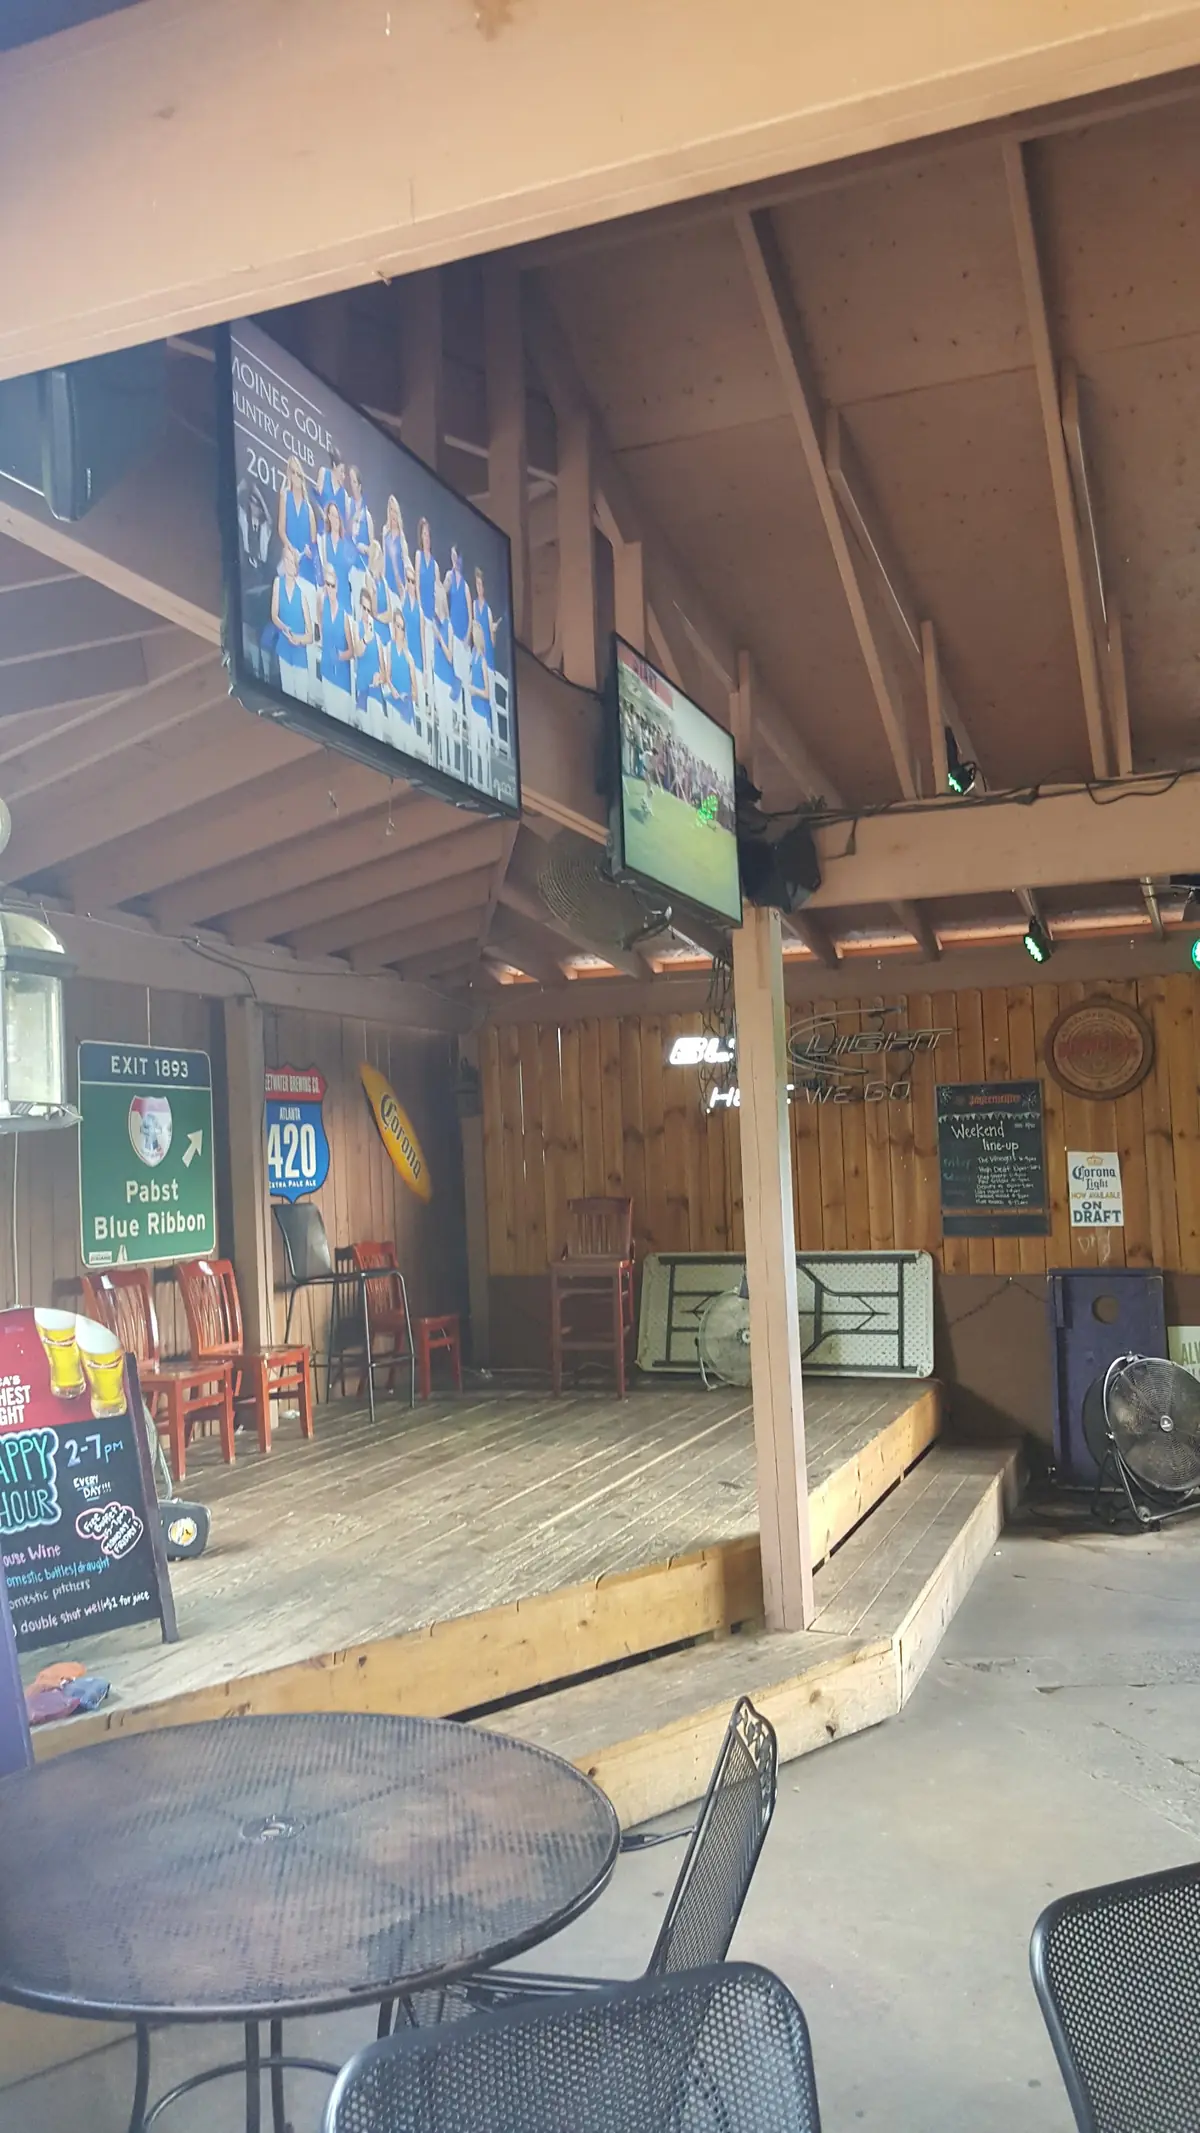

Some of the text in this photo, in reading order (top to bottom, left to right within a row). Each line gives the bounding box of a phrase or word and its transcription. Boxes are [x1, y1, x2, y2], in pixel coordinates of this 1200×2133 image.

[232, 390, 315, 467] UNTRY CLUB
[294, 408, 333, 452] GOLF
[246, 447, 288, 492] 2017
[806, 1028, 953, 1056] LIGHT
[111, 1055, 189, 1078] EXIT 1893
[805, 1085, 853, 1104] WE
[864, 1081, 912, 1100] GO
[279, 1106, 302, 1121] ATLANTA
[381, 1093, 421, 1180] Corona
[951, 1120, 1005, 1140] Weekend
[267, 1122, 317, 1179] 420
[982, 1138, 1020, 1162] line-up
[1072, 1164, 1117, 1181] Corona
[1086, 1178, 1109, 1191] Light
[126, 1178, 179, 1203] Pabst
[1071, 1191, 1121, 1200] NOW AVAILABLE
[1073, 1209, 1122, 1223] DRAFT
[1082, 1201, 1102, 1210] ON
[94, 1210, 206, 1240] Blue Ribbon
[73, 1474, 99, 1489] EVERY
[3, 1543, 62, 1568] ouse Wine
[6, 1569, 44, 1588] omestic
[8, 1578, 91, 1610] omestic pitchers
[20, 1612, 59, 1635] double
[60, 1605, 82, 1624] shot
[119, 1594, 131, 1607] for
[131, 1590, 151, 1607] juice
